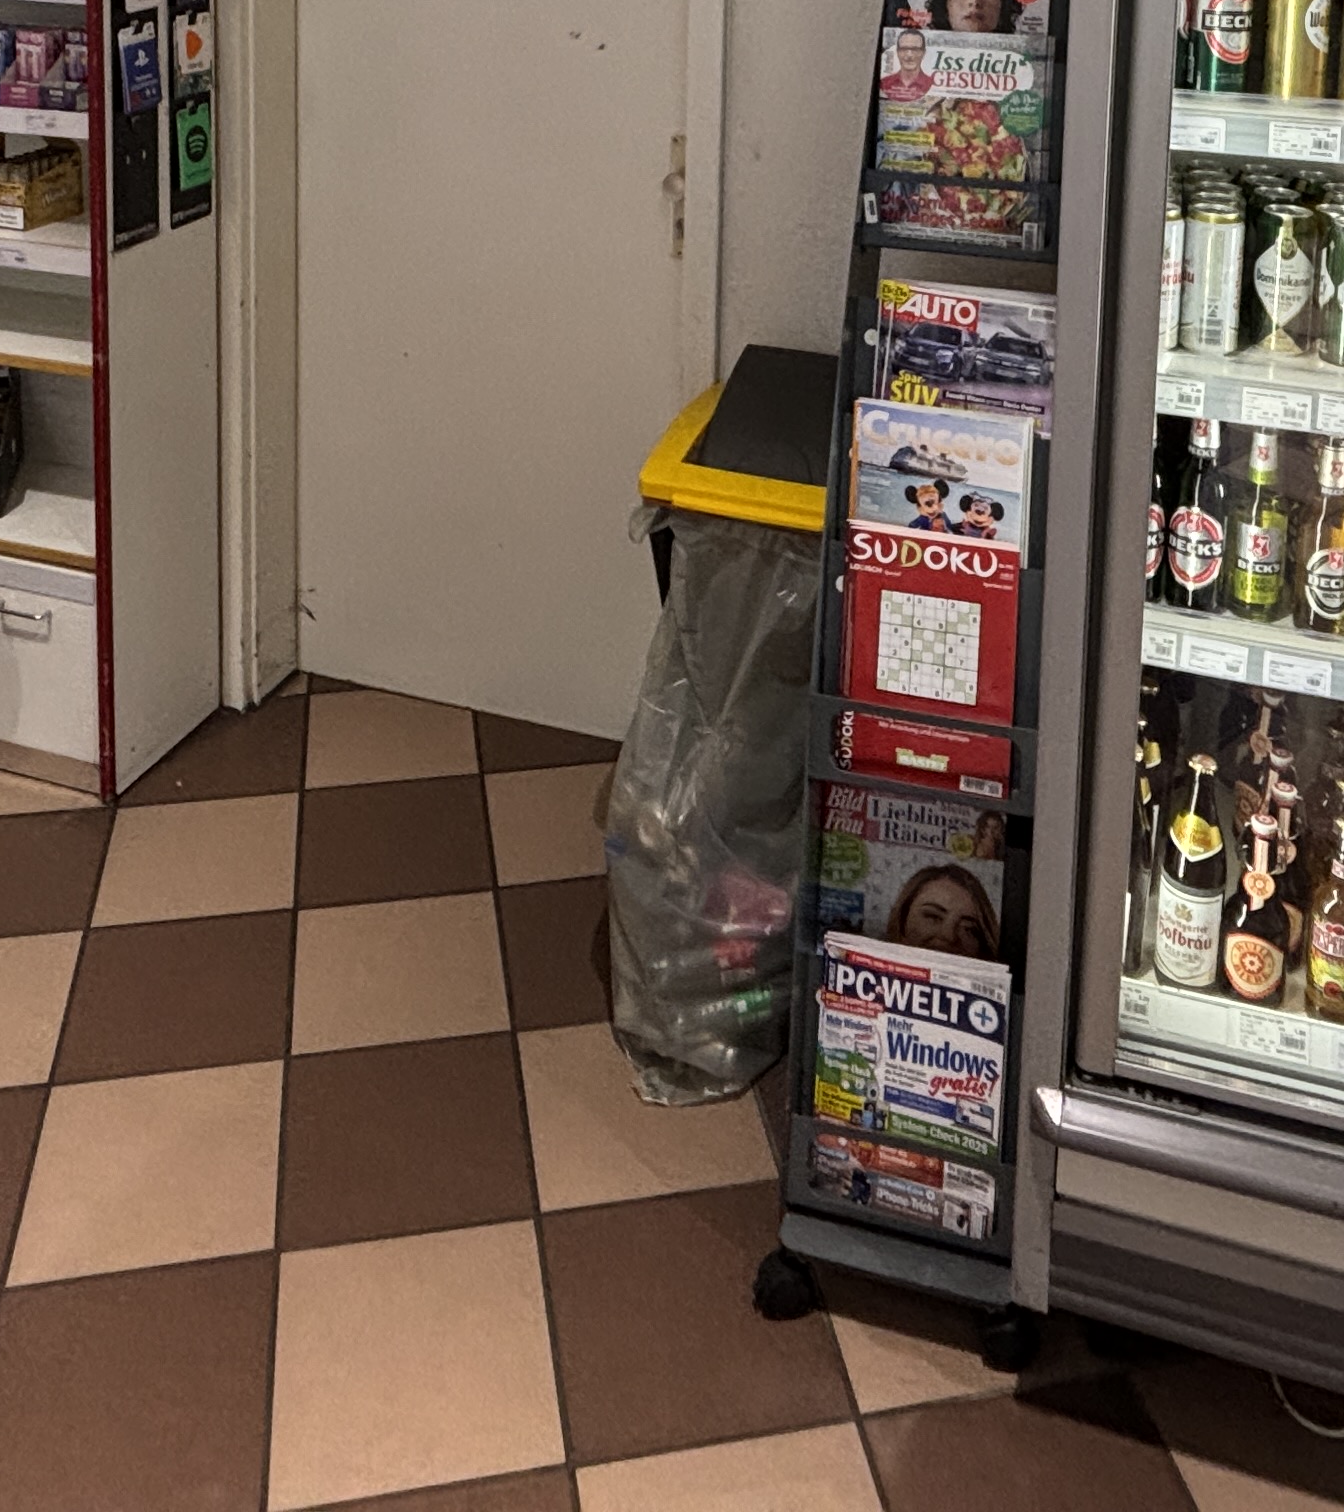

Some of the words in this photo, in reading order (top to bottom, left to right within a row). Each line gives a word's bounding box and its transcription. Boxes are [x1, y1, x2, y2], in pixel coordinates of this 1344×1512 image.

[933, 50, 965, 70] Iss
[968, 52, 1018, 75] dich
[932, 70, 1018, 91] GESUND
[896, 292, 977, 326] AUTO
[898, 369, 926, 384] Spar-
[890, 380, 940, 407] SUV
[852, 533, 998, 578] SUDOKU
[1170, 537, 1224, 556] BECK'S
[1237, 559, 1281, 574] BECK'S
[883, 818, 948, 847] Rätsel
[887, 1016, 915, 1034] Mehr
[887, 1030, 998, 1082] Windows
[929, 1073, 998, 1104] gratis!
